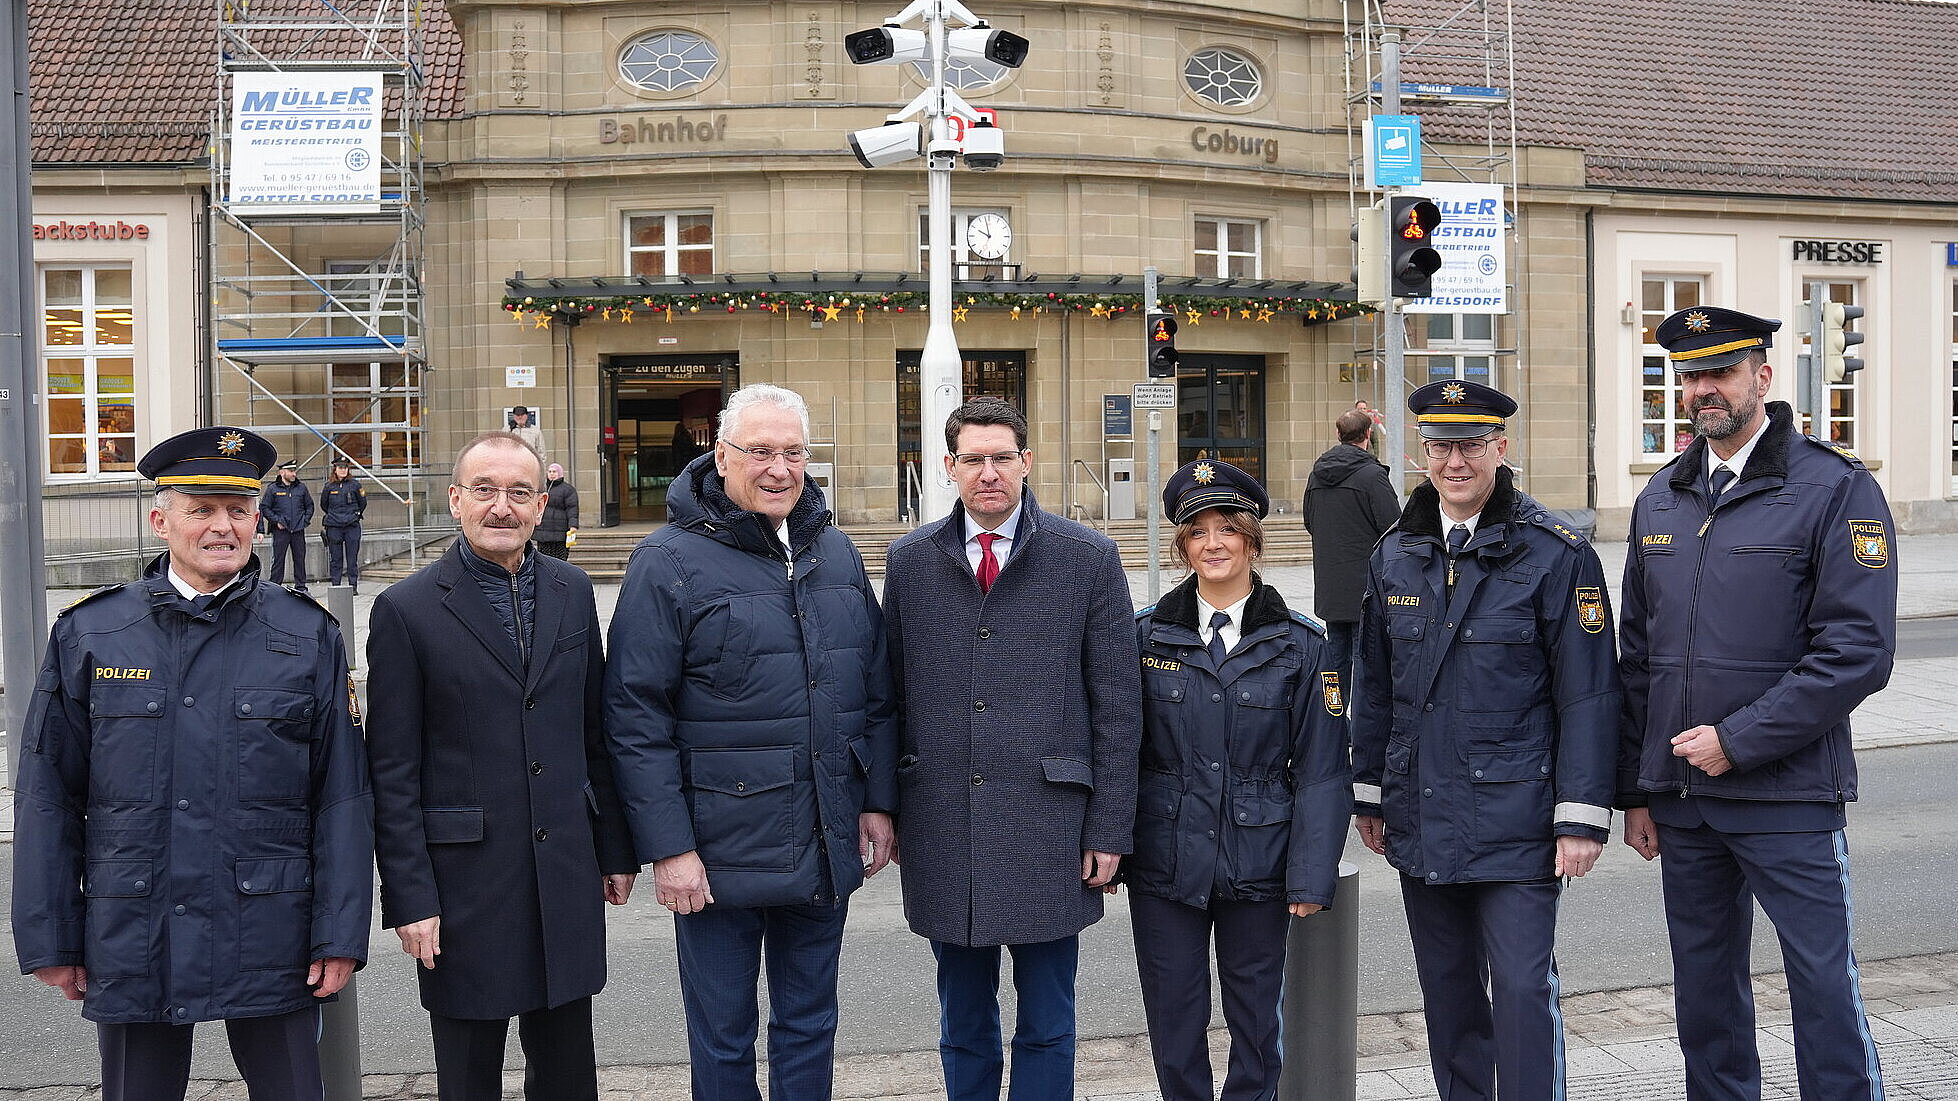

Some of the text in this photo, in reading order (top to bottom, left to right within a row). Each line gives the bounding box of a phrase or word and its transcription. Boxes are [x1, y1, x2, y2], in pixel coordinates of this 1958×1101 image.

[241, 87, 374, 112] MÜLLER
[240, 116, 373, 131] GERÜSTBAU
[599, 113, 728, 144] Bahnhof
[251, 138, 363, 146] MEISTERBETRIEB
[1191, 126, 1279, 163] Coburg
[238, 183, 375, 193] www.mueller-geruestbau.de
[32, 221, 150, 240] ackstube
[1793, 240, 1883, 264] PRESSE
[1413, 297, 1502, 306] ATTELSDORF
[1853, 524, 1883, 534] POLIZEI
[1642, 534, 1673, 545] POLIZEI
[1387, 596, 1420, 607] POLIZEI
[1142, 657, 1182, 671] POLIZEI
[95, 667, 151, 681] POLIZEI
